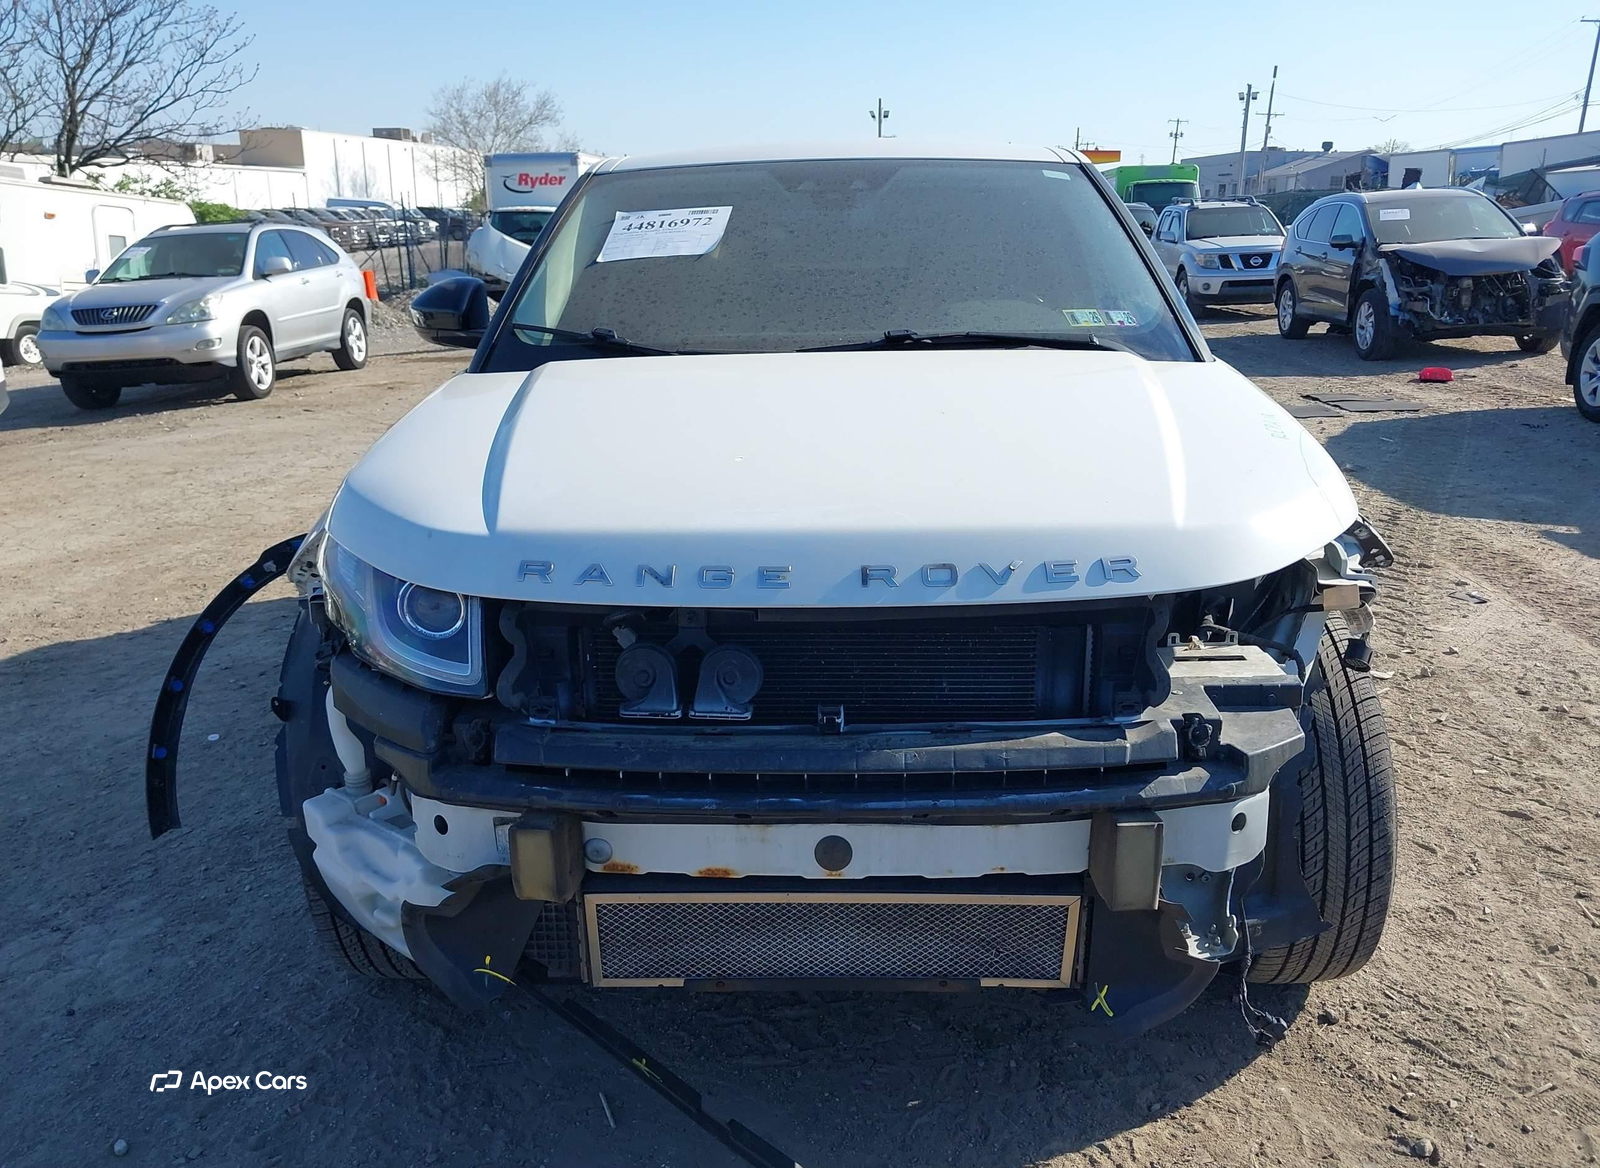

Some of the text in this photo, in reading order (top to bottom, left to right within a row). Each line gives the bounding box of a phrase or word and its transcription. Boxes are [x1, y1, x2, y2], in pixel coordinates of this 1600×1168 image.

[518, 172, 566, 189] Ryder
[622, 216, 713, 232] 44816972
[517, 554, 1143, 589] RANGE ROVER
